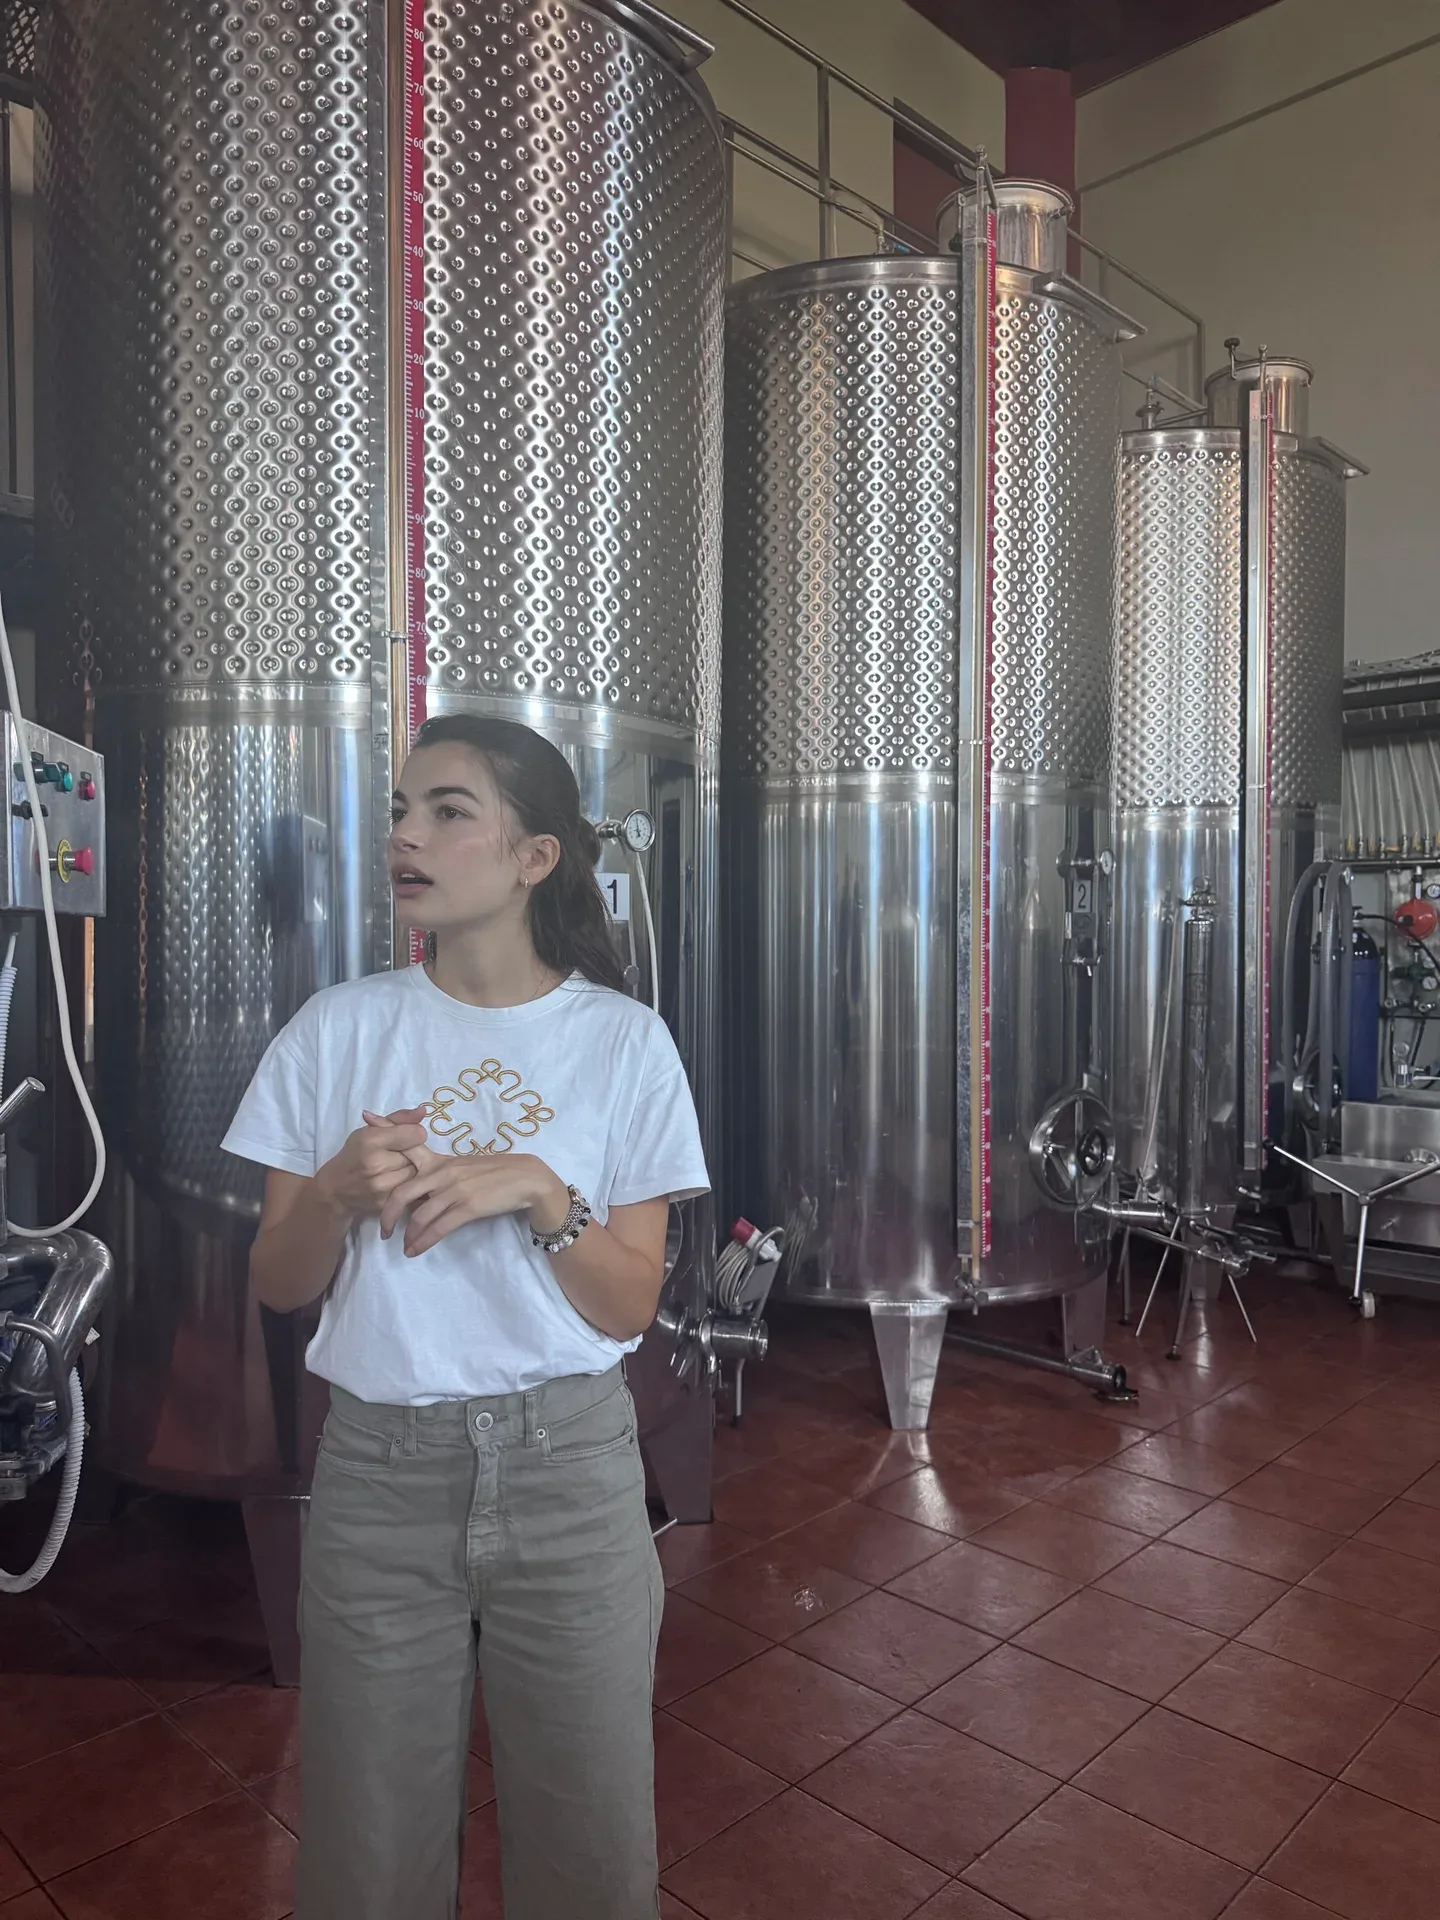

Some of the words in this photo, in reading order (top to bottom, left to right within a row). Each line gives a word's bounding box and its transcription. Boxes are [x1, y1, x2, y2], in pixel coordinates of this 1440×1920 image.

[414, 28, 424, 42] 80
[414, 82, 424, 96] 70
[414, 137, 424, 150] 60
[413, 190, 424, 204] 50
[413, 245, 424, 258] 40
[413, 299, 424, 312] 30
[413, 353, 424, 366] 20
[414, 407, 425, 420] 10
[415, 513, 425, 525] 90
[415, 567, 426, 579] 80
[416, 621, 426, 633] 70
[416, 674, 427, 686] 60
[607, 879, 617, 914] 1
[1077, 883, 1086, 909] 2
